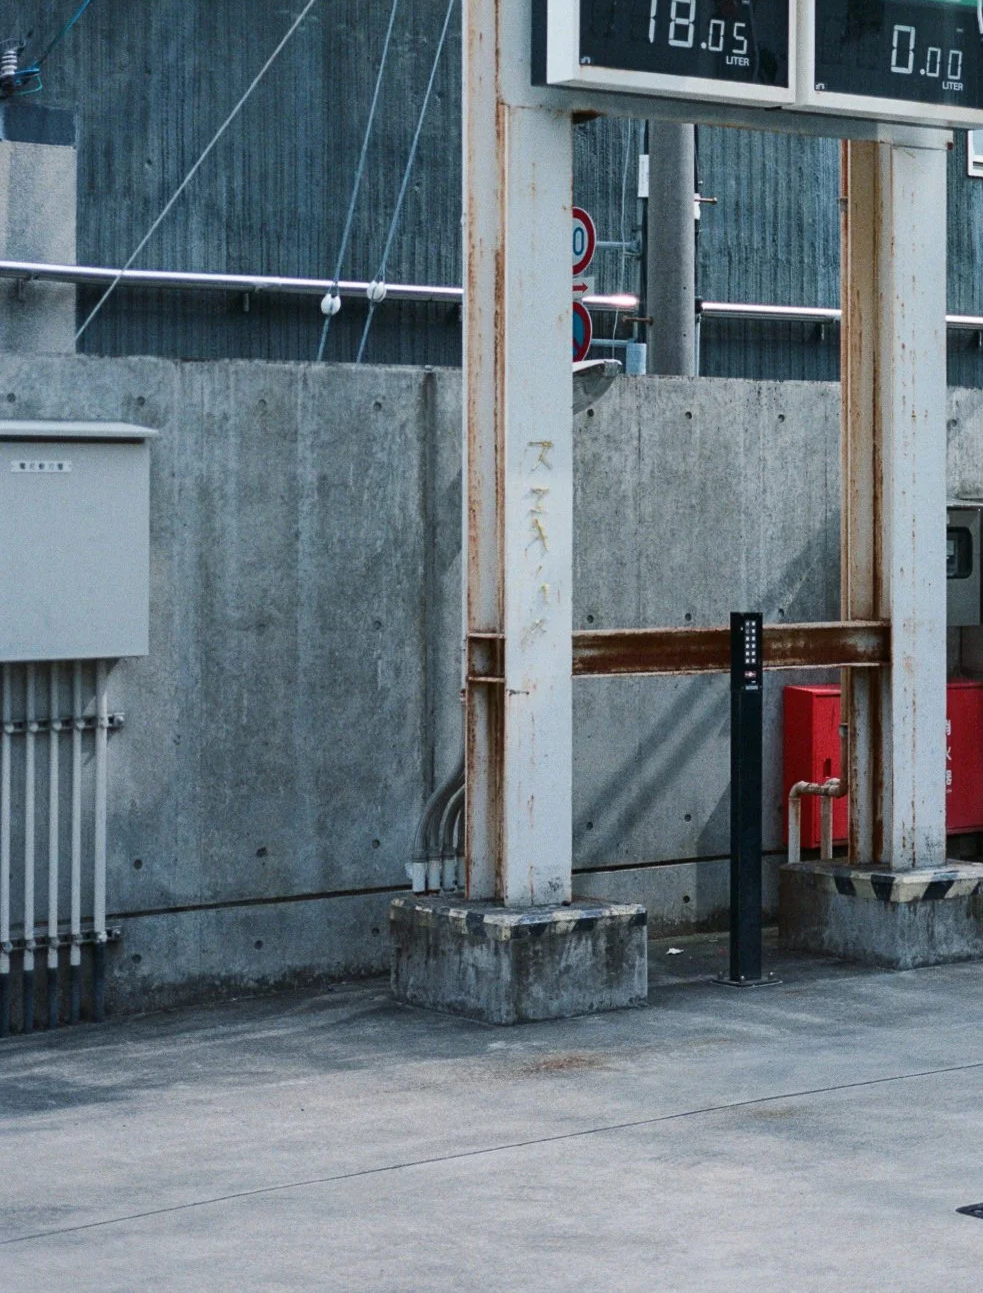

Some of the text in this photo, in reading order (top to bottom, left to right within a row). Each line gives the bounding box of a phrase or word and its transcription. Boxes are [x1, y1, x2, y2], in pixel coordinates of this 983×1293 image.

[890, 24, 963, 80] 0.00
[725, 55, 750, 66] LITER
[942, 81, 964, 91] LITER
